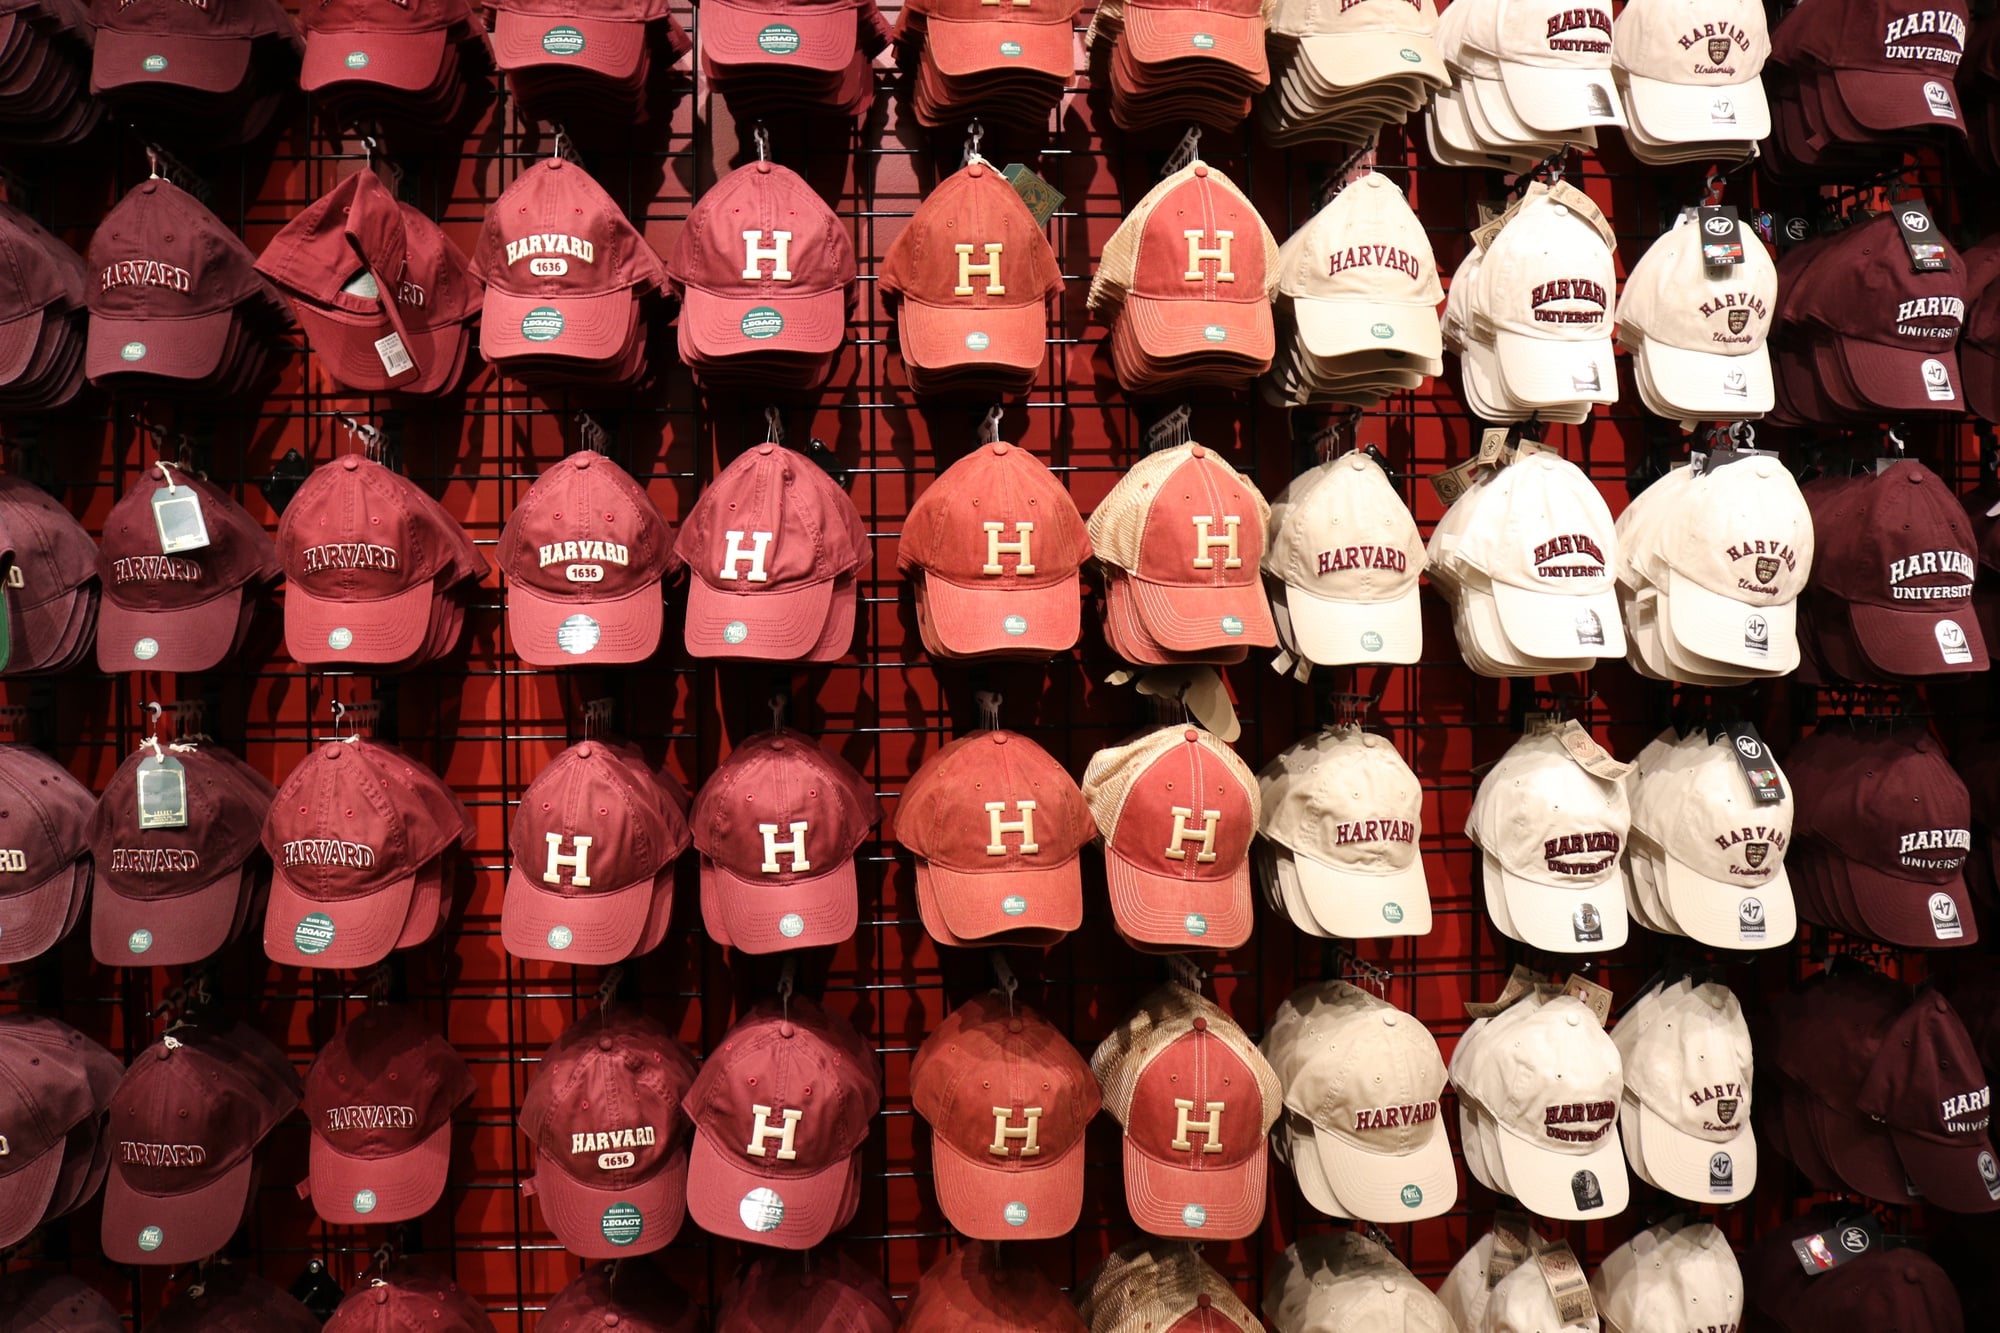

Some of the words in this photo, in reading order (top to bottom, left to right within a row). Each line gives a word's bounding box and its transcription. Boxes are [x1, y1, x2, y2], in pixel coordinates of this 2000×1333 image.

[1679, 22, 1750, 52] HARVARD
[505, 233, 594, 266] HARVARD
[742, 230, 792, 281] H
[1183, 229, 1235, 282] H
[1328, 244, 1419, 281] HARVARD
[100, 259, 193, 296] HARVARD
[535, 260, 562, 273] 1636
[954, 243, 1005, 296] H
[1534, 308, 1605, 324] UNIVERSITY
[1699, 292, 1767, 320] HARVARD
[523, 320, 562, 328] LEGACY
[742, 319, 782, 329] LEGACY
[539, 540, 629, 568] HARVARD
[720, 530, 773, 582] H
[983, 521, 1035, 575] H
[1192, 515, 1242, 569] H
[1726, 540, 1797, 574] HARVARD
[113, 555, 202, 585] HARVARD
[302, 543, 400, 576] HARVARD
[571, 568, 598, 578] 1636
[1318, 545, 1407, 576] HARVARD
[1537, 565, 1605, 578] UNIVERSITY
[1892, 583, 1974, 600] UNIVERSITY
[985, 800, 1038, 855] H
[1165, 806, 1221, 862] H
[1336, 819, 1415, 846] HARVARD
[1715, 826, 1786, 852] HARVARD
[111, 848, 200, 873] HARVARD
[282, 839, 375, 869] HARVARD
[543, 831, 593, 887] H
[759, 820, 810, 873] H
[1547, 855, 1616, 876] UNIVERSITY
[296, 926, 333, 940] LEGACY
[327, 1105, 418, 1131] HARVARD
[989, 1106, 1044, 1156] H
[1171, 1098, 1225, 1153] H
[1355, 1100, 1437, 1132] HARVARD
[571, 1126, 656, 1154] HARVARD
[746, 1104, 803, 1160] H
[120, 1141, 207, 1168] HARVARD
[603, 1155, 630, 1167] 1636
[602, 1218, 641, 1227] LEGACY
